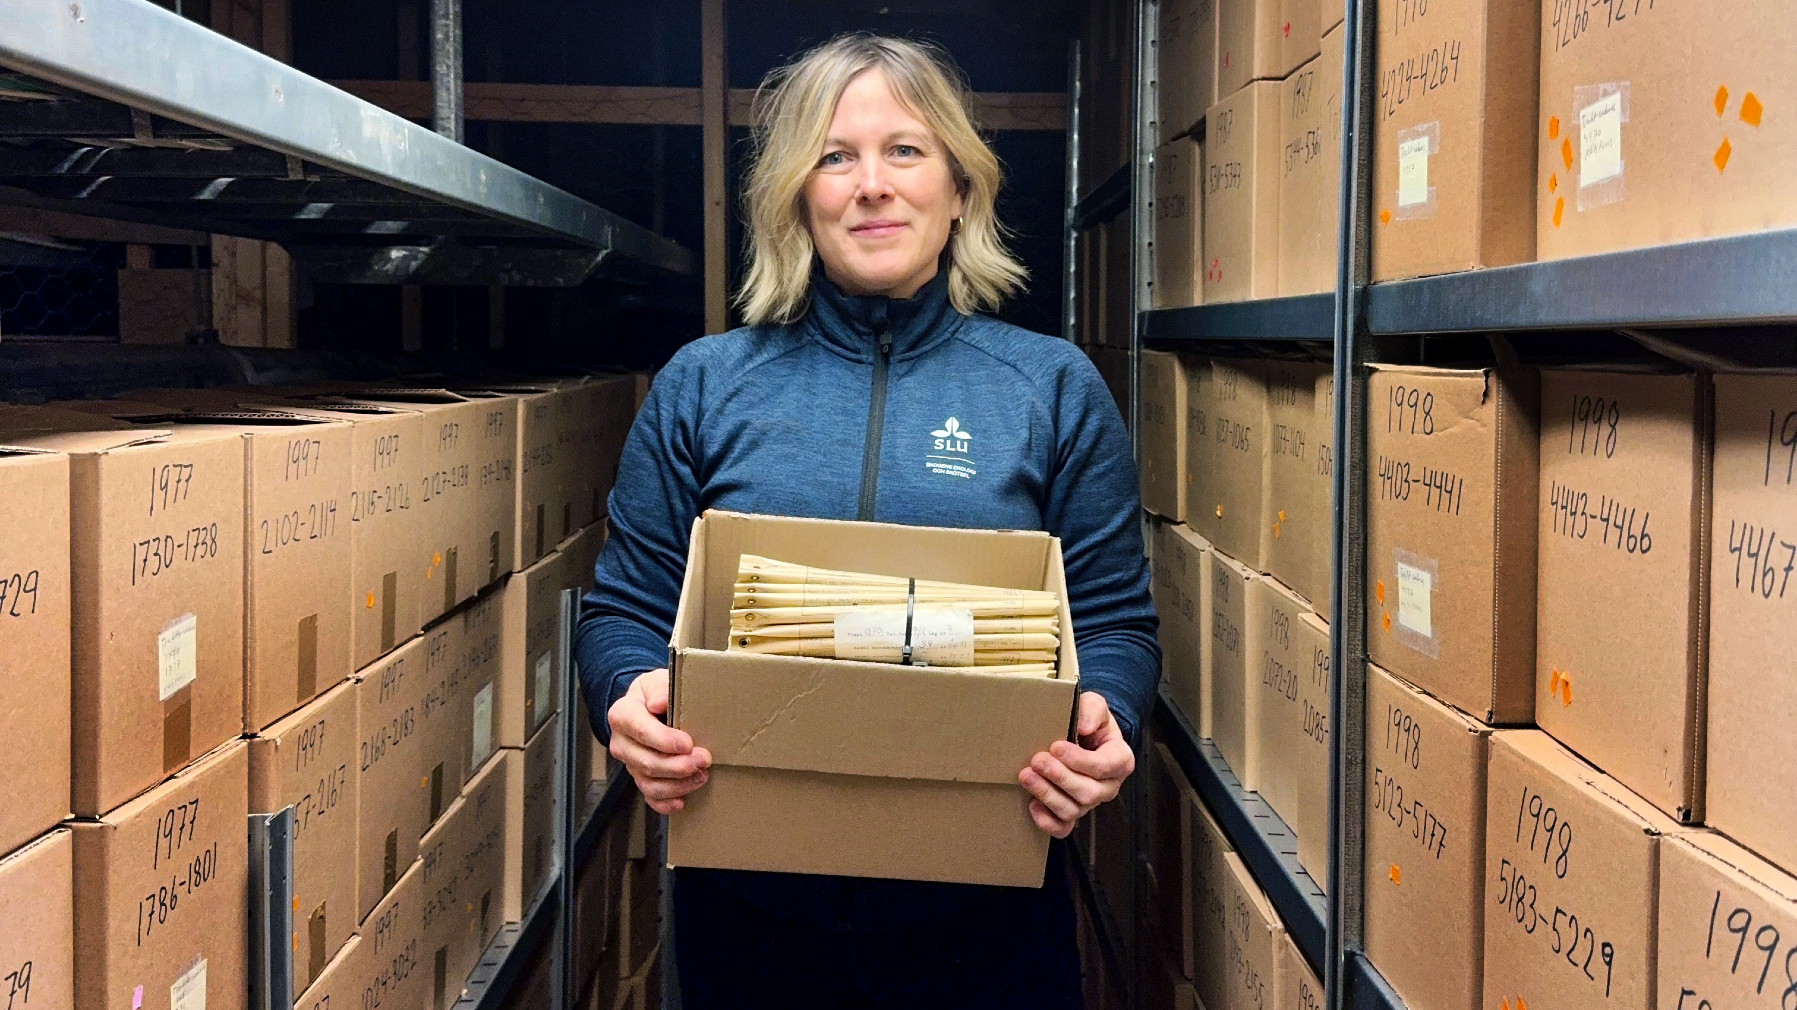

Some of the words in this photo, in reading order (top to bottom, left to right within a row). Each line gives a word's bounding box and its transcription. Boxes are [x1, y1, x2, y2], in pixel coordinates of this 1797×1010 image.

[1382, 40, 1460, 121] 4224-4264
[439, 423, 459, 452] 1997
[1388, 386, 1434, 436] 1998
[1569, 395, 1619, 458] 1998
[286, 439, 320, 482] 1997
[374, 435, 399, 473] 1997
[934, 438, 968, 454] SLU
[150, 464, 194, 517] 1977
[352, 483, 410, 522] 2115-2126
[1379, 456, 1463, 516] 4403-4441
[262, 500, 337, 554] 2102-2114
[1551, 480, 1652, 554] 4443-4466
[132, 522, 218, 587] 1730-1738
[1729, 519, 1797, 599] 4467
[1271, 605, 1289, 650] 1998
[380, 659, 404, 704] 1997
[296, 719, 325, 772] 1997
[1387, 704, 1421, 769] 1998
[154, 798, 199, 870] 1977
[1375, 767, 1447, 860] 5123-5177
[1517, 787, 1572, 879] 1998
[137, 842, 217, 947] 1786-1801
[374, 902, 399, 956] 1997
[1498, 859, 1614, 998] 5183-5229
